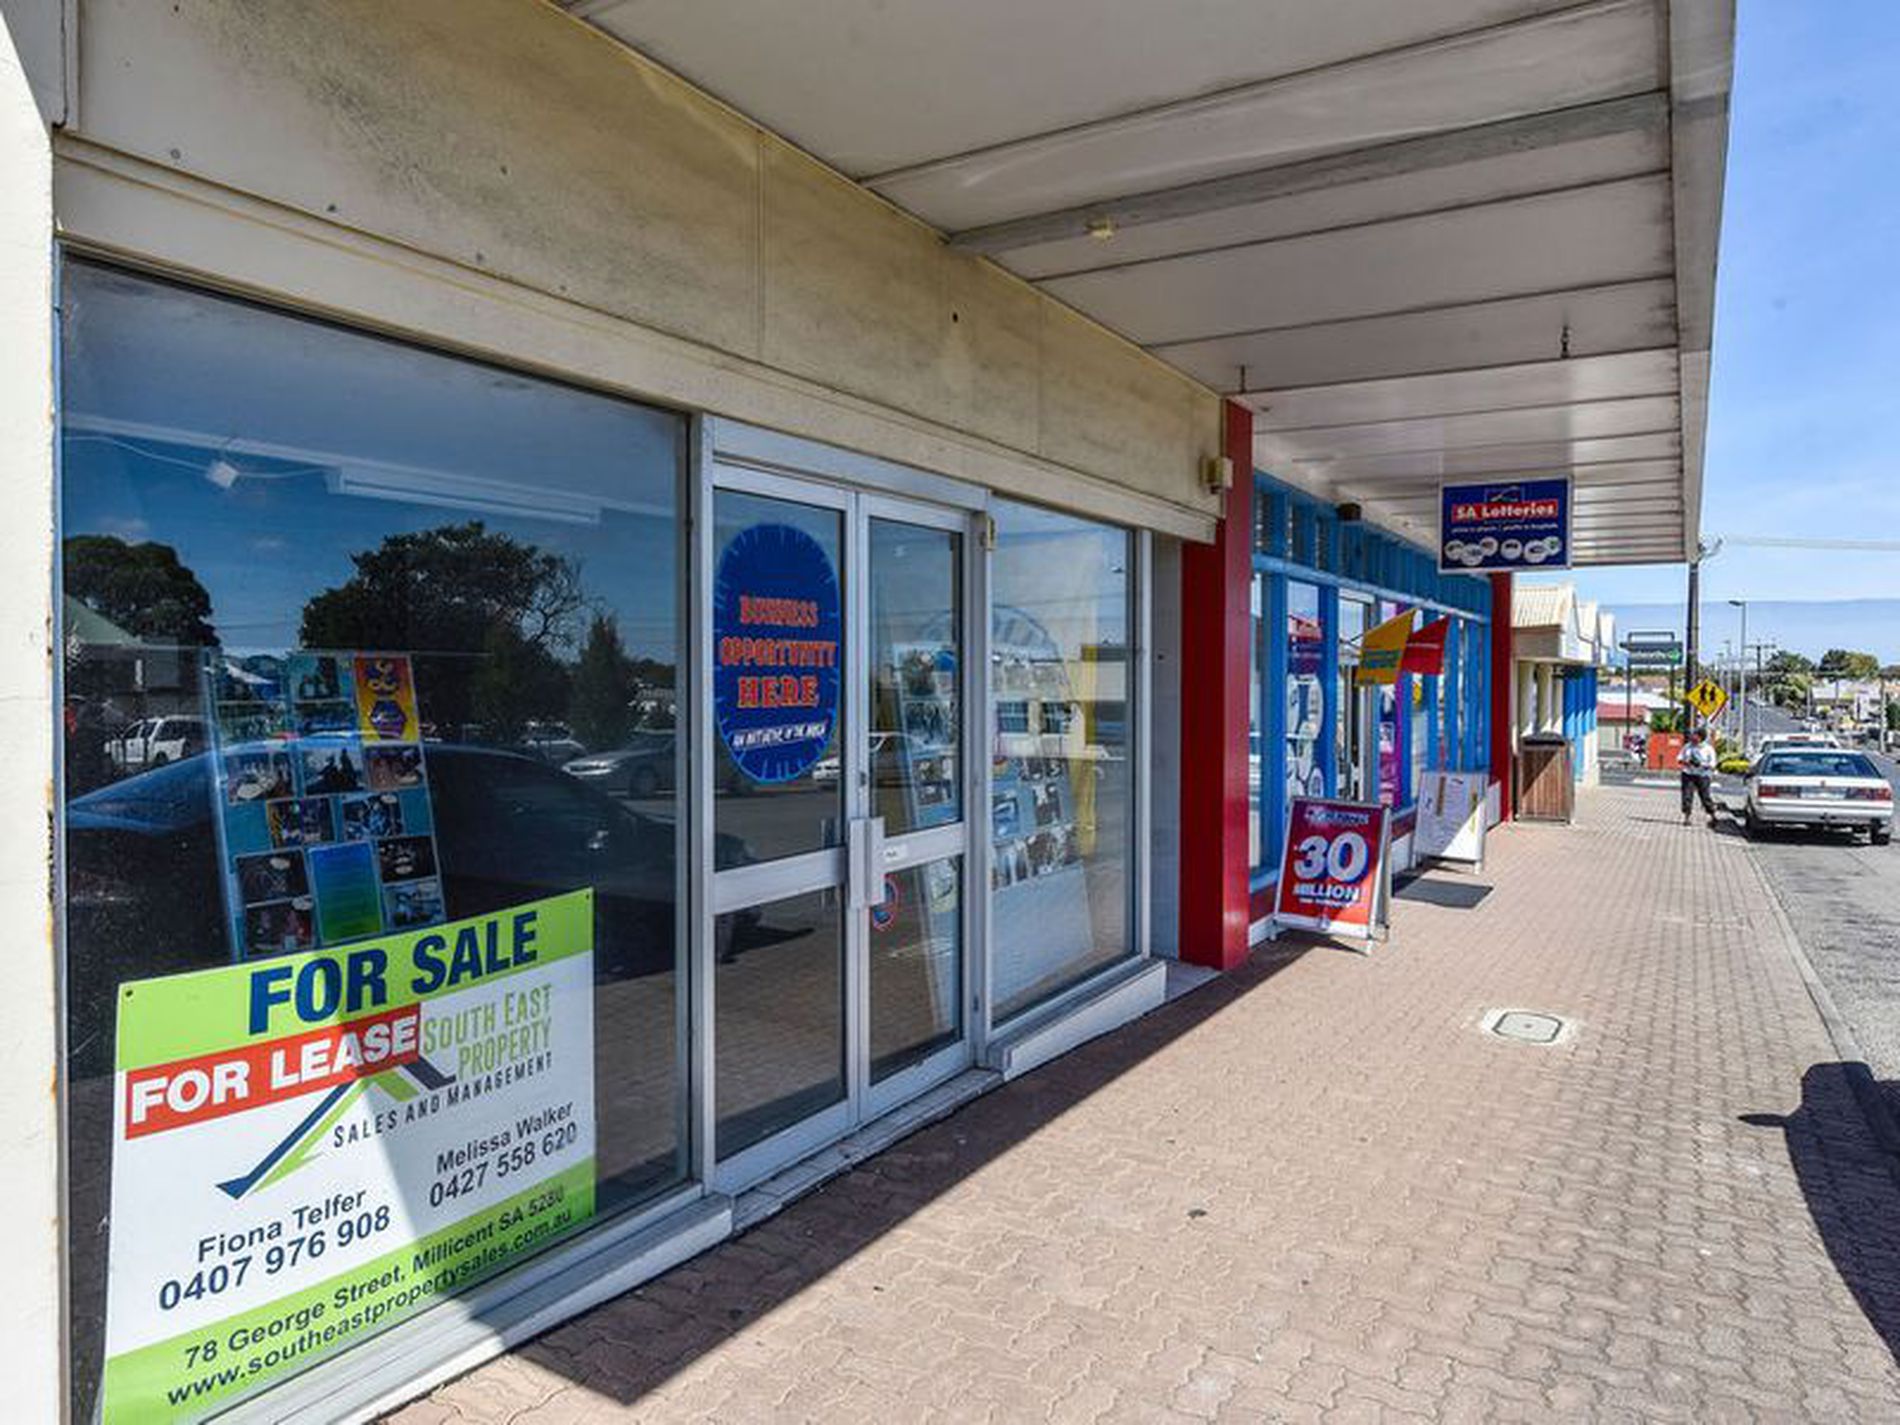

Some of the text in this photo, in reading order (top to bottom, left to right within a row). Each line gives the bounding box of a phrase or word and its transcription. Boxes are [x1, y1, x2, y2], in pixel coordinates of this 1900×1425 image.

[1456, 500, 1556, 521] SA Lotteries
[721, 636, 836, 667] OPPORTUNITY
[738, 674, 819, 708] HERE
[1294, 832, 1368, 882] 30
[249, 911, 537, 1035] FOR SALE
[423, 984, 552, 1054] SOUTH EAST
[458, 1018, 553, 1080] PROPERTY
[131, 1014, 418, 1125] FOR LEASE
[334, 1051, 552, 1148] SALES AND MANAGEMENT
[429, 1122, 577, 1207] 0427 558 620
[436, 1102, 573, 1175] Melissa Walker
[159, 1205, 390, 1310] 0407 976 908
[198, 1190, 366, 1262] Fiona Telfer
[168, 1210, 571, 1406] www.southeastpropertysales.com.au
[185, 1185, 564, 1369] 78 George Street, Millicent SA 5280
